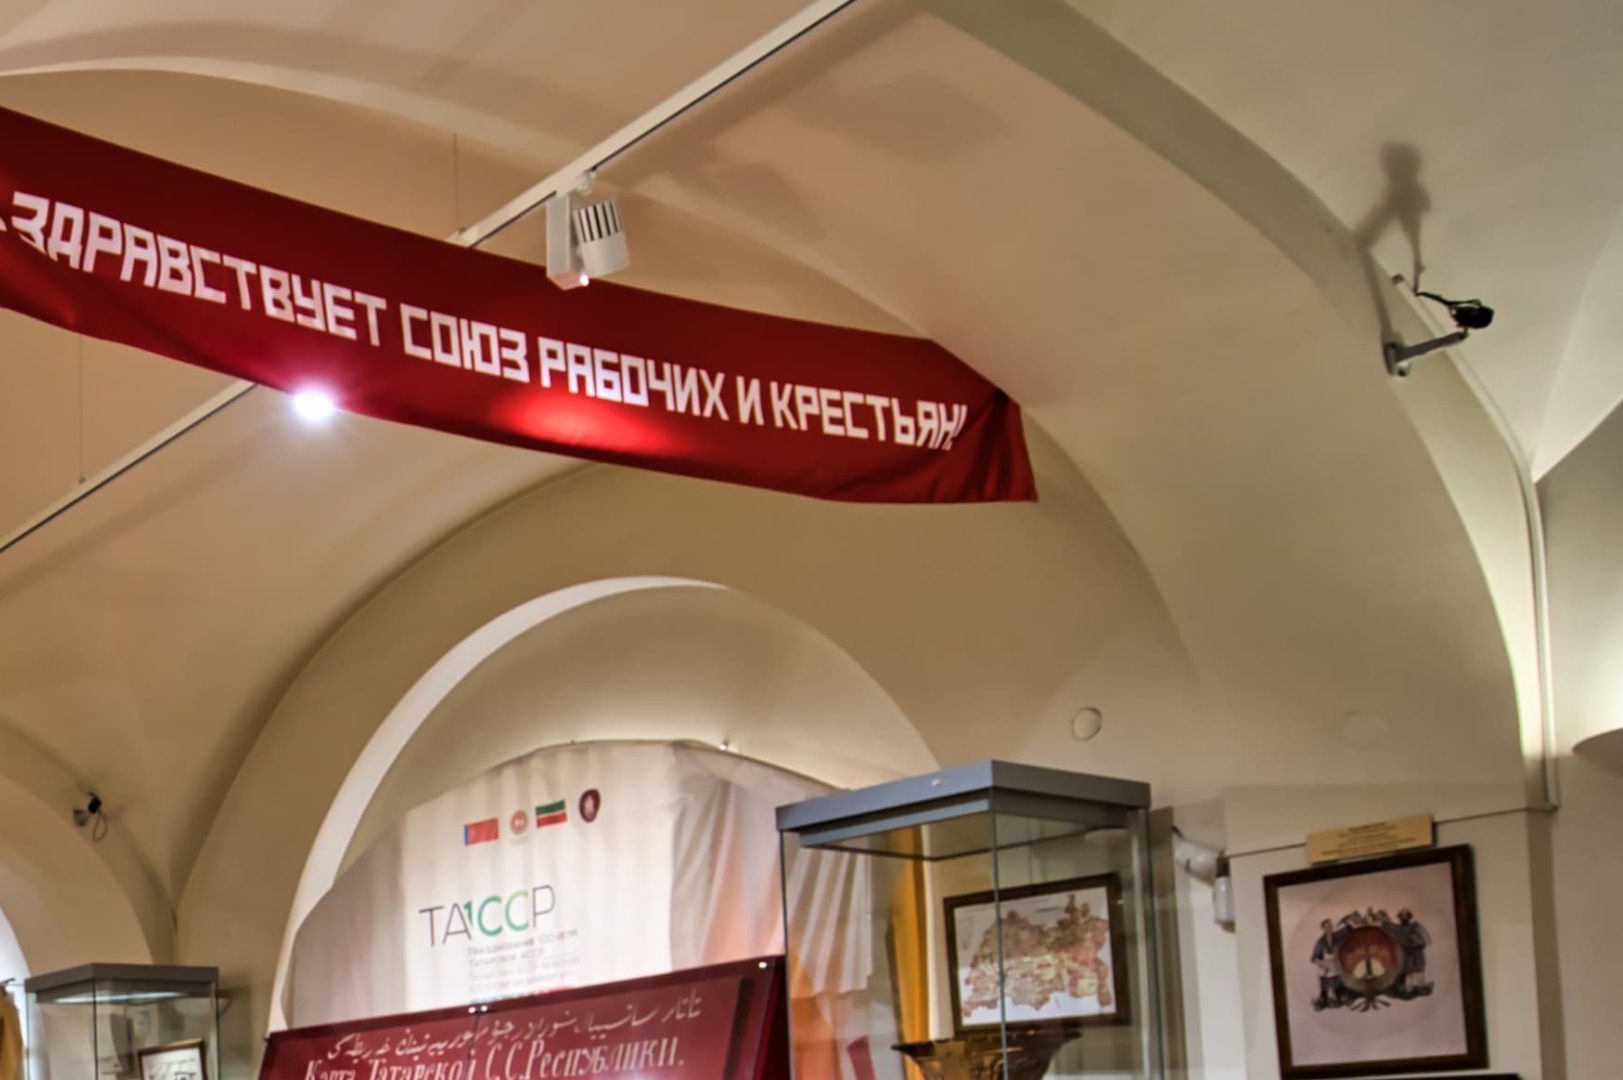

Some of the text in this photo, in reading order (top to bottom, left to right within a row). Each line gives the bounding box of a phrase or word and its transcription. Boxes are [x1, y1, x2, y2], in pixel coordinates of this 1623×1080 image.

[11, 191, 387, 347] ЗДРАВСТВУЕТ
[399, 303, 530, 383] СОЮЗ
[537, 335, 730, 422] РАБОЧИХ
[736, 375, 764, 426] И
[770, 381, 967, 451] КРЕСТЬЯН!
